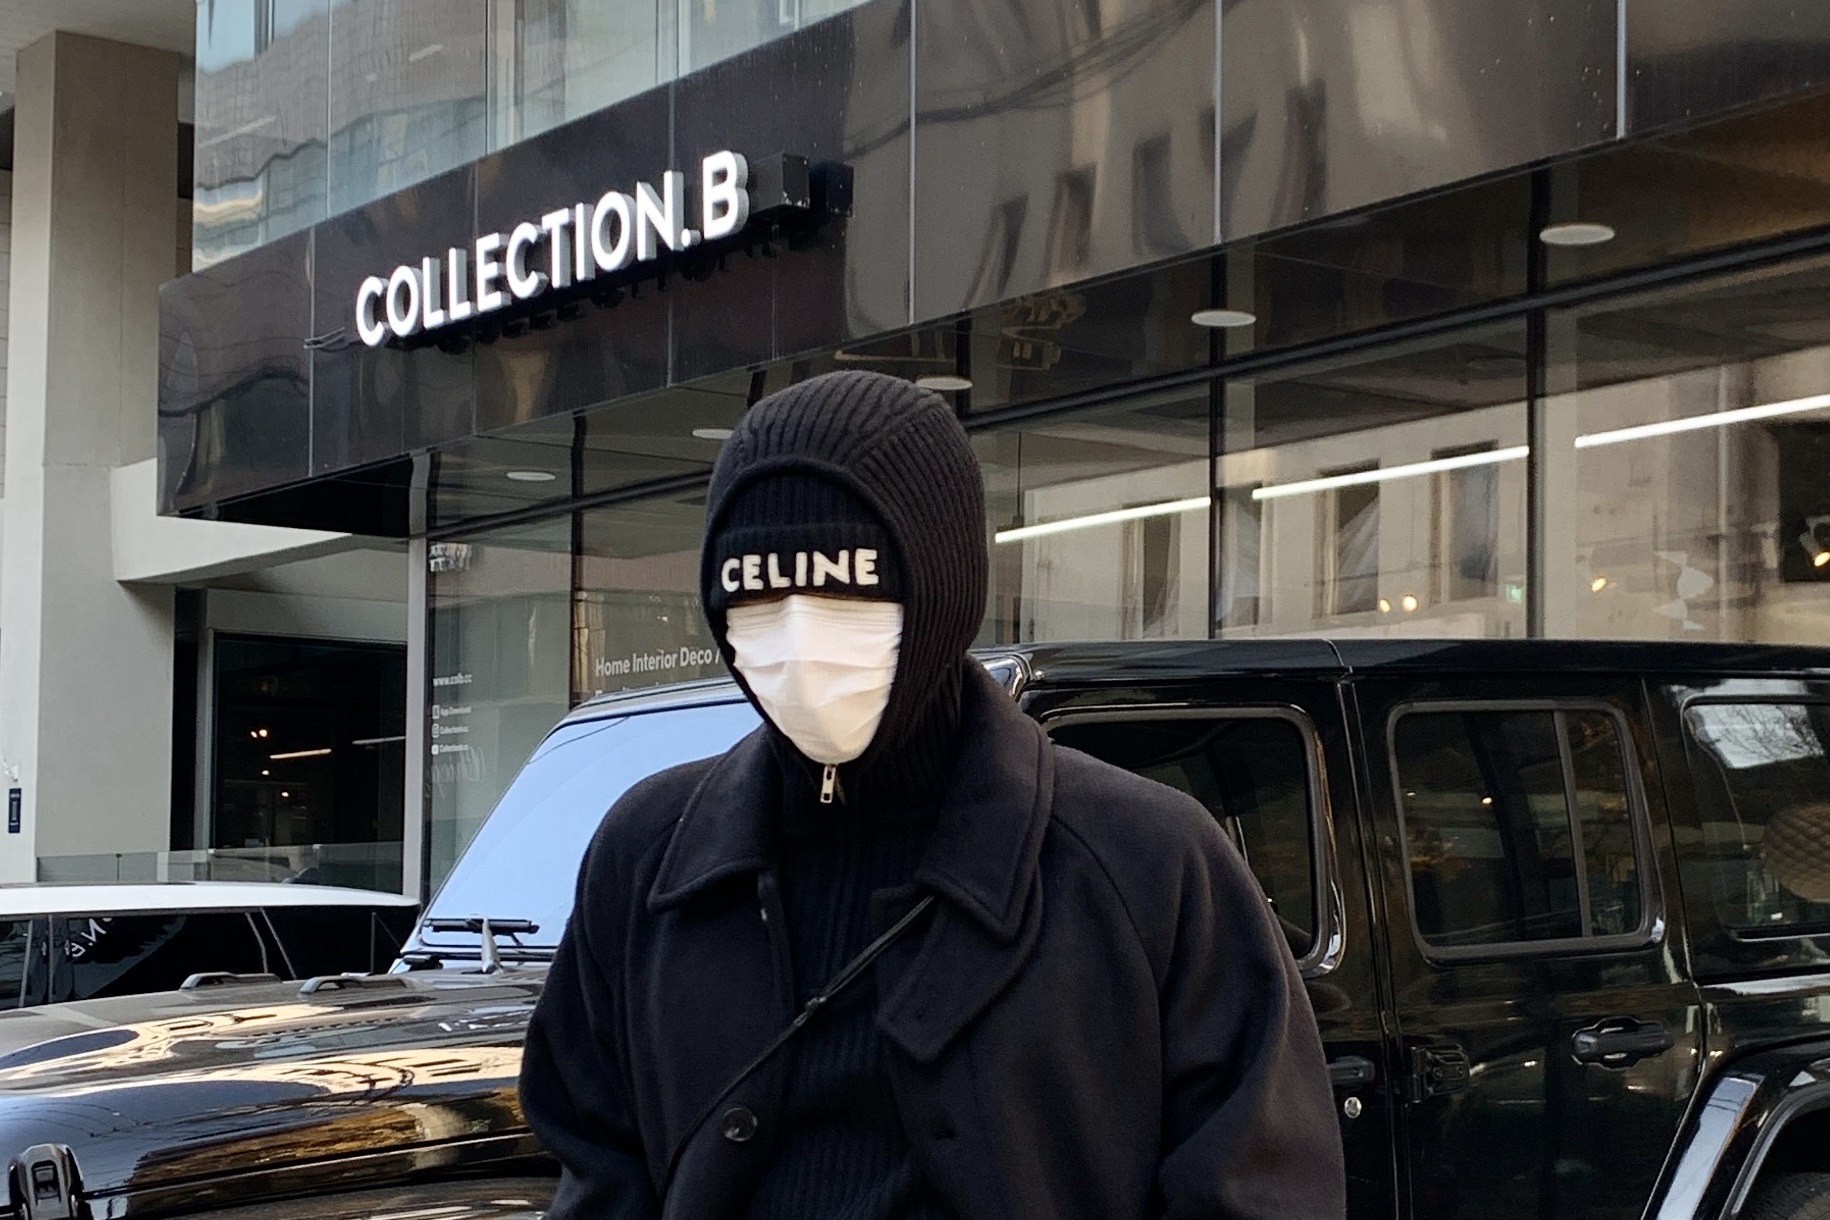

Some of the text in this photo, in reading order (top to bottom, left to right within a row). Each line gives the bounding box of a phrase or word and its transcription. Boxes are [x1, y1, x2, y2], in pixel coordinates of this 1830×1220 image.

[355, 150, 749, 346] COLLECTION.B
[721, 548, 879, 592] CELINE
[595, 657, 631, 677] Home
[632, 649, 679, 673] Interior
[680, 646, 713, 667] Deco
